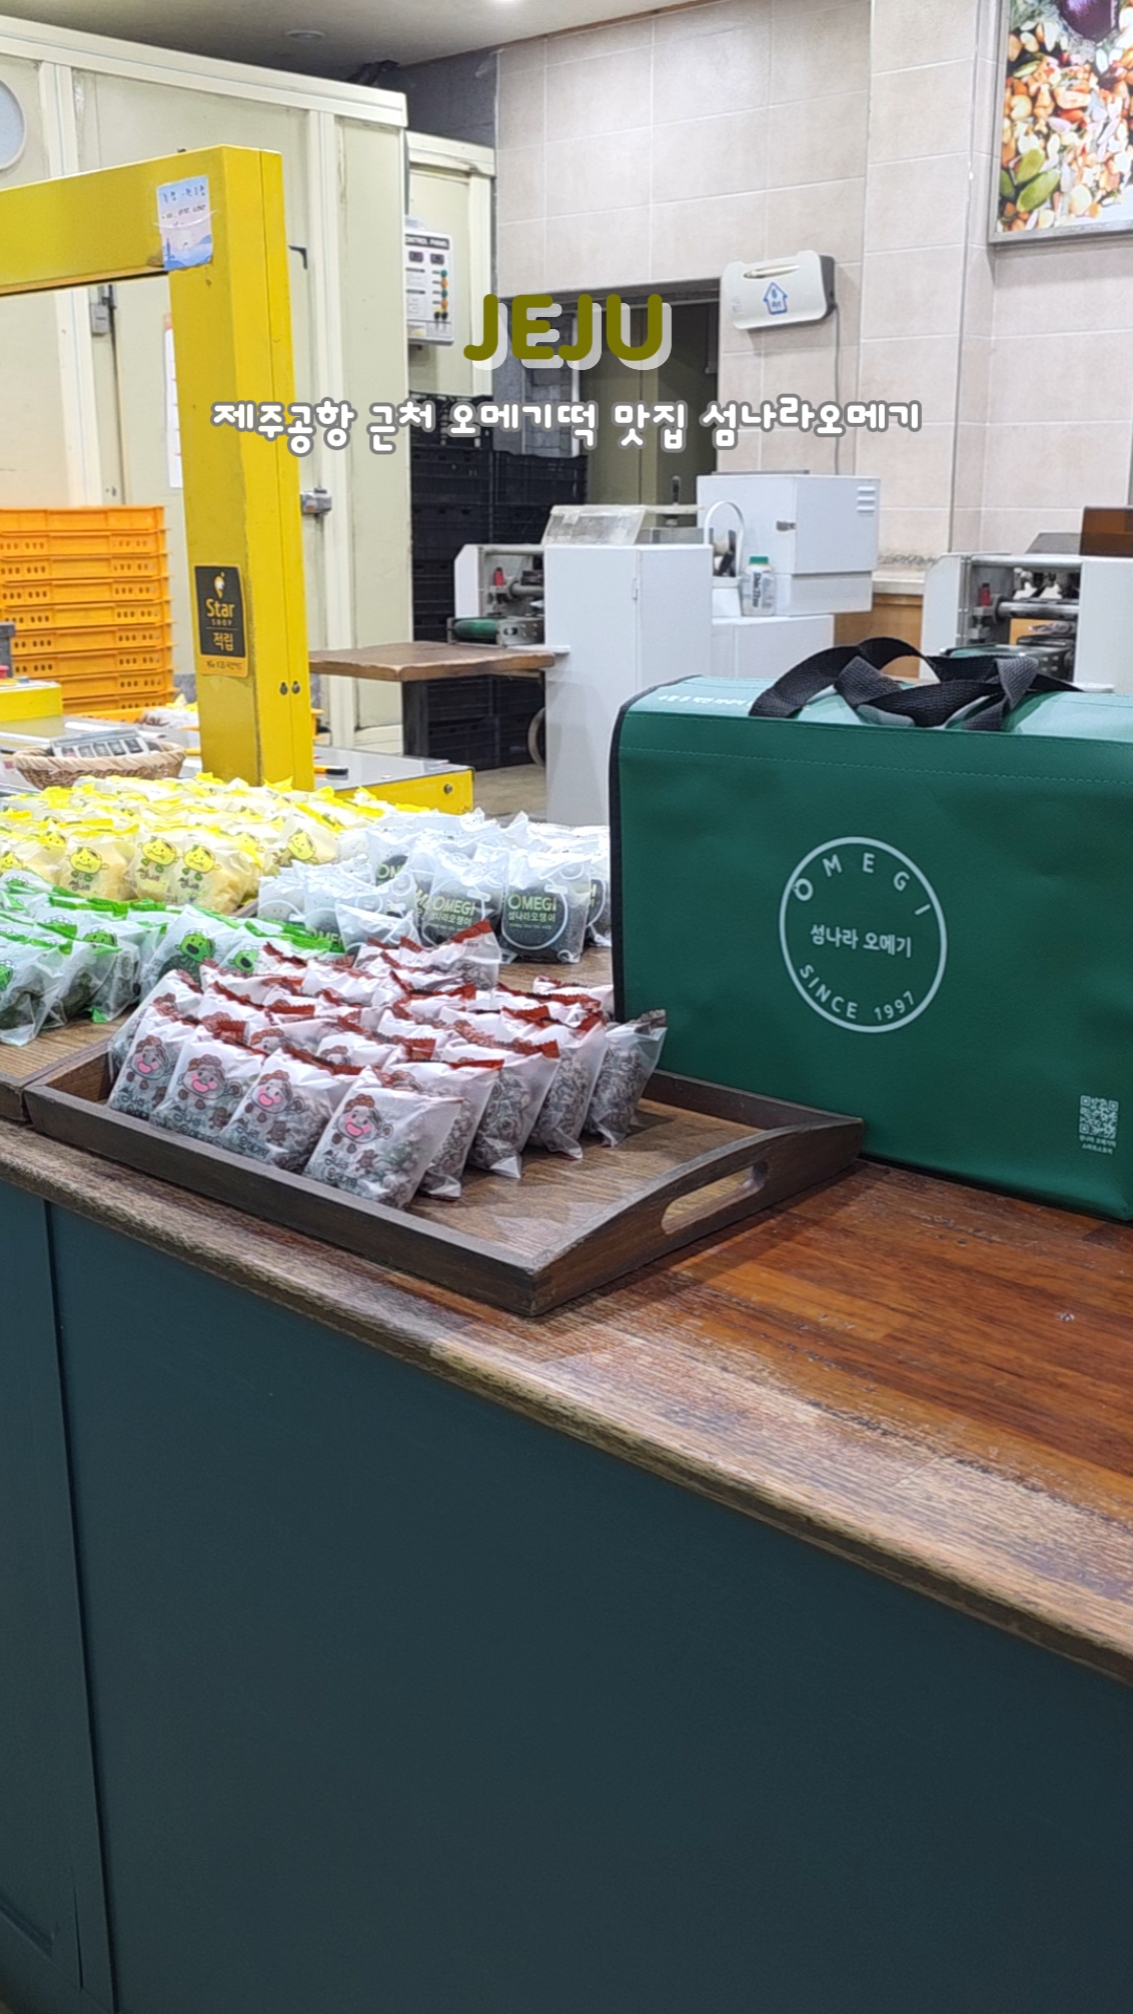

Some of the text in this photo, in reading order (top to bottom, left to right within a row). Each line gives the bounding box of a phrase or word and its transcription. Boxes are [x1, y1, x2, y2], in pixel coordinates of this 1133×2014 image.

[205, 598, 235, 618] Star
[213, 632, 234, 651] 적립
[793, 852, 931, 915] OMEGI
[433, 896, 476, 916] OMEGI
[508, 893, 557, 911] OMEGI
[810, 924, 911, 959] 섬나라 오메기
[799, 964, 915, 1021] SINCE 1997
